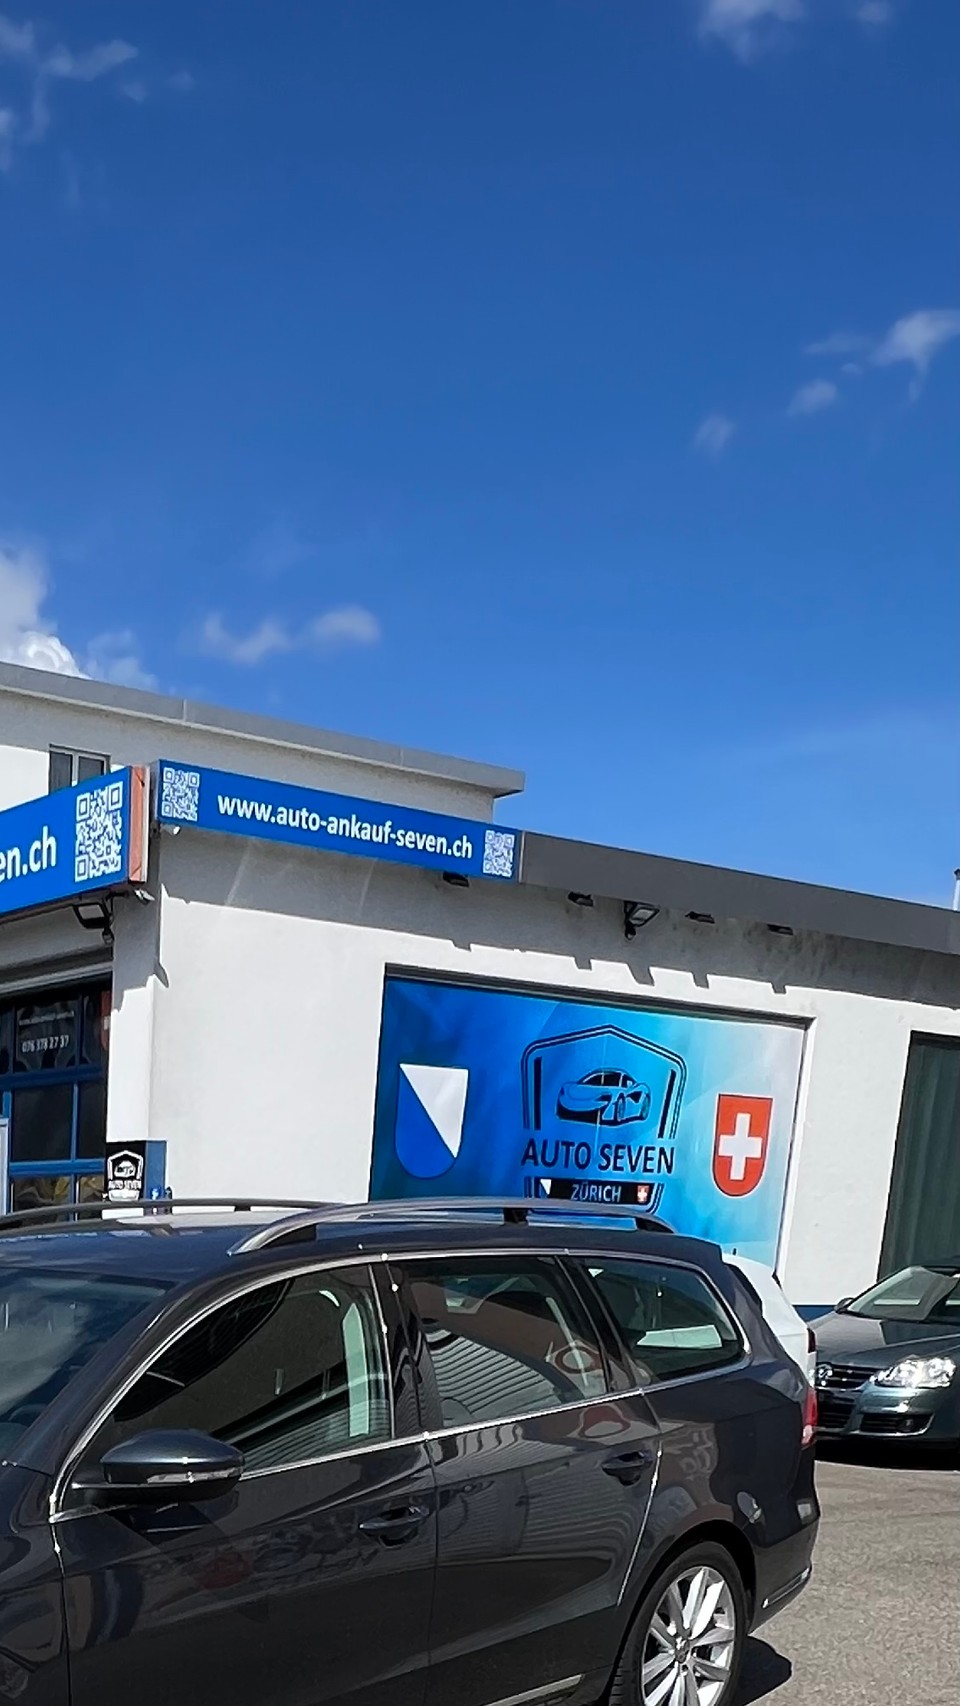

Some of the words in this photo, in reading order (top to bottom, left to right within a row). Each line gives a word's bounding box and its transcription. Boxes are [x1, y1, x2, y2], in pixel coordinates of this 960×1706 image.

[217, 794, 473, 859] www.auto-ankauf-seven.ch
[49, 1036, 59, 1049] 27
[521, 1138, 592, 1171] AUTO
[597, 1143, 675, 1175] SEVEN
[570, 1181, 622, 1203] ZÜRICH
